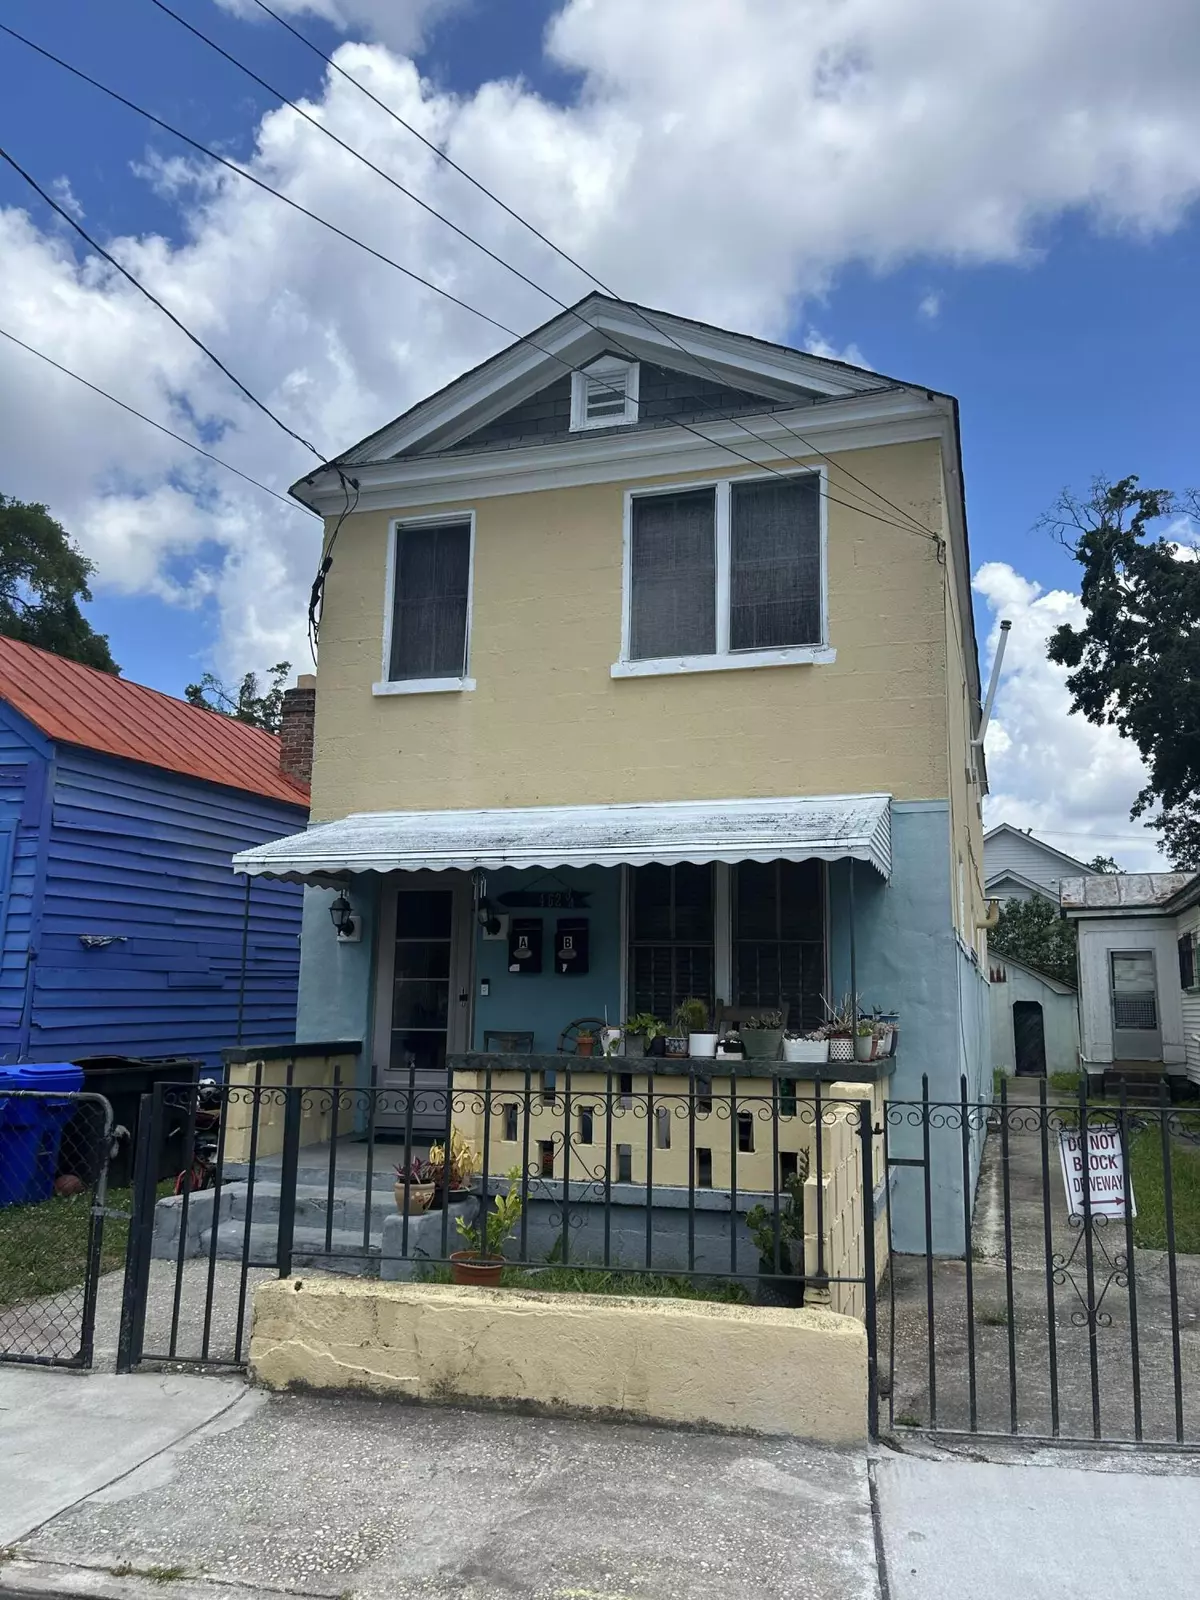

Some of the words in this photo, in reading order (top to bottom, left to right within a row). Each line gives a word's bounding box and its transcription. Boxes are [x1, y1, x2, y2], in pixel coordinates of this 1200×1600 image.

[519, 937, 527, 948] A
[564, 937, 571, 948] B
[1090, 1134, 1116, 1150] NOT
[1073, 1154, 1118, 1171] BOCK
[1073, 1175, 1123, 1193] DVEWAY
